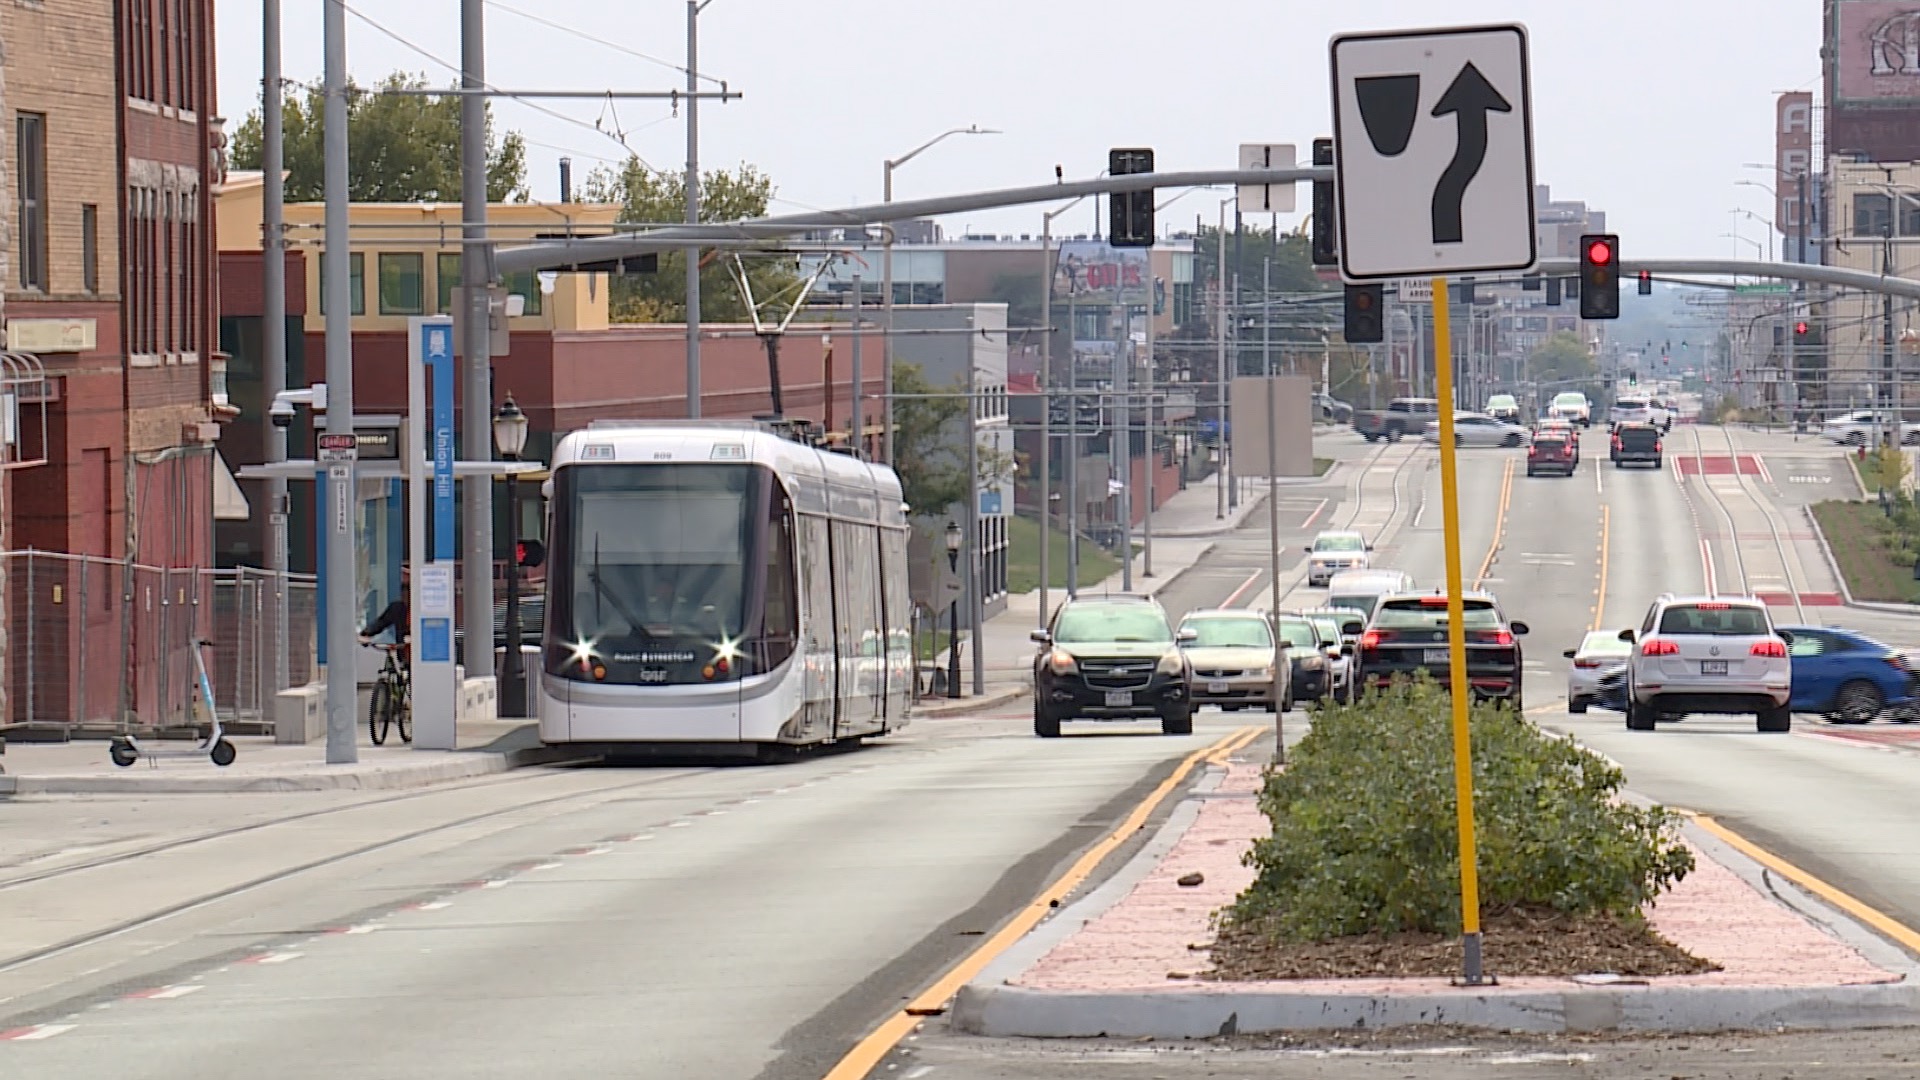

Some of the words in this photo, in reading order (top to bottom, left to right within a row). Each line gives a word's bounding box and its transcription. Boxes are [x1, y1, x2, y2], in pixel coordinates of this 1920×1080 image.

[1404, 279, 1433, 288] FLASHI
[437, 428, 450, 469] Union
[437, 473, 450, 498] Hill
